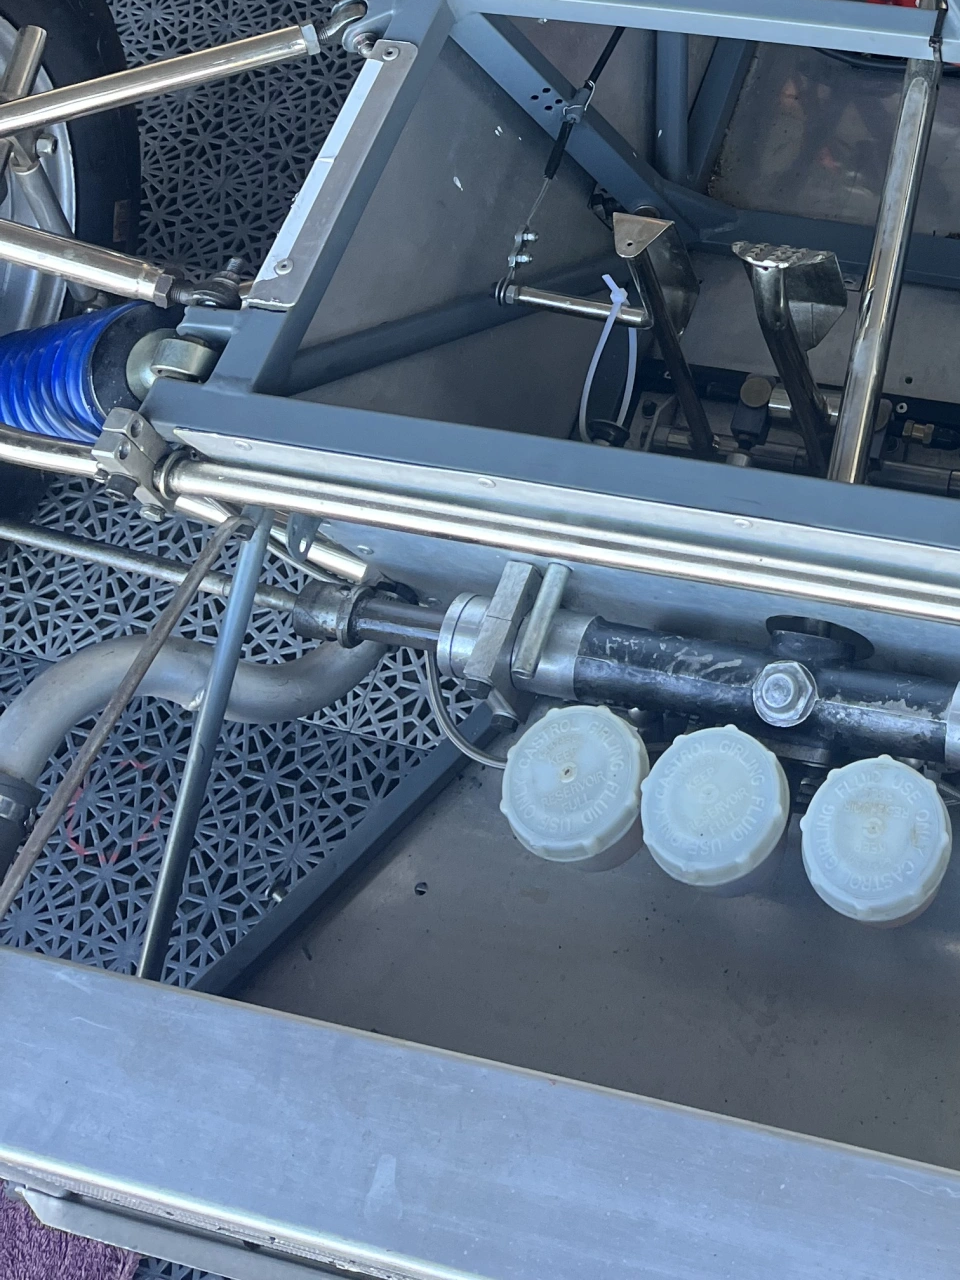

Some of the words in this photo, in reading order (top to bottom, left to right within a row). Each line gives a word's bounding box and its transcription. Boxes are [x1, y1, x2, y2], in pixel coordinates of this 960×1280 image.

[518, 719, 580, 769] CASTROL
[587, 721, 625, 771] GIRLING
[719, 740, 765, 786] GIRLING
[541, 771, 606, 807] RESERVOIR
[655, 741, 712, 799] CASTROL
[685, 766, 715, 791] KEEP
[834, 770, 882, 799] FLUID
[514, 778, 536, 818] ONLY
[561, 793, 595, 815] FULL
[580, 780, 620, 824] FLUID
[688, 786, 748, 830] RESERVOIR
[891, 778, 922, 804] USE
[538, 815, 572, 832] USE
[653, 807, 682, 846] ONLY
[709, 812, 740, 836] FULL
[730, 795, 765, 841] FLUID
[816, 804, 838, 870] GIRLING
[688, 838, 722, 855] USE
[844, 860, 914, 892] CASTROL
